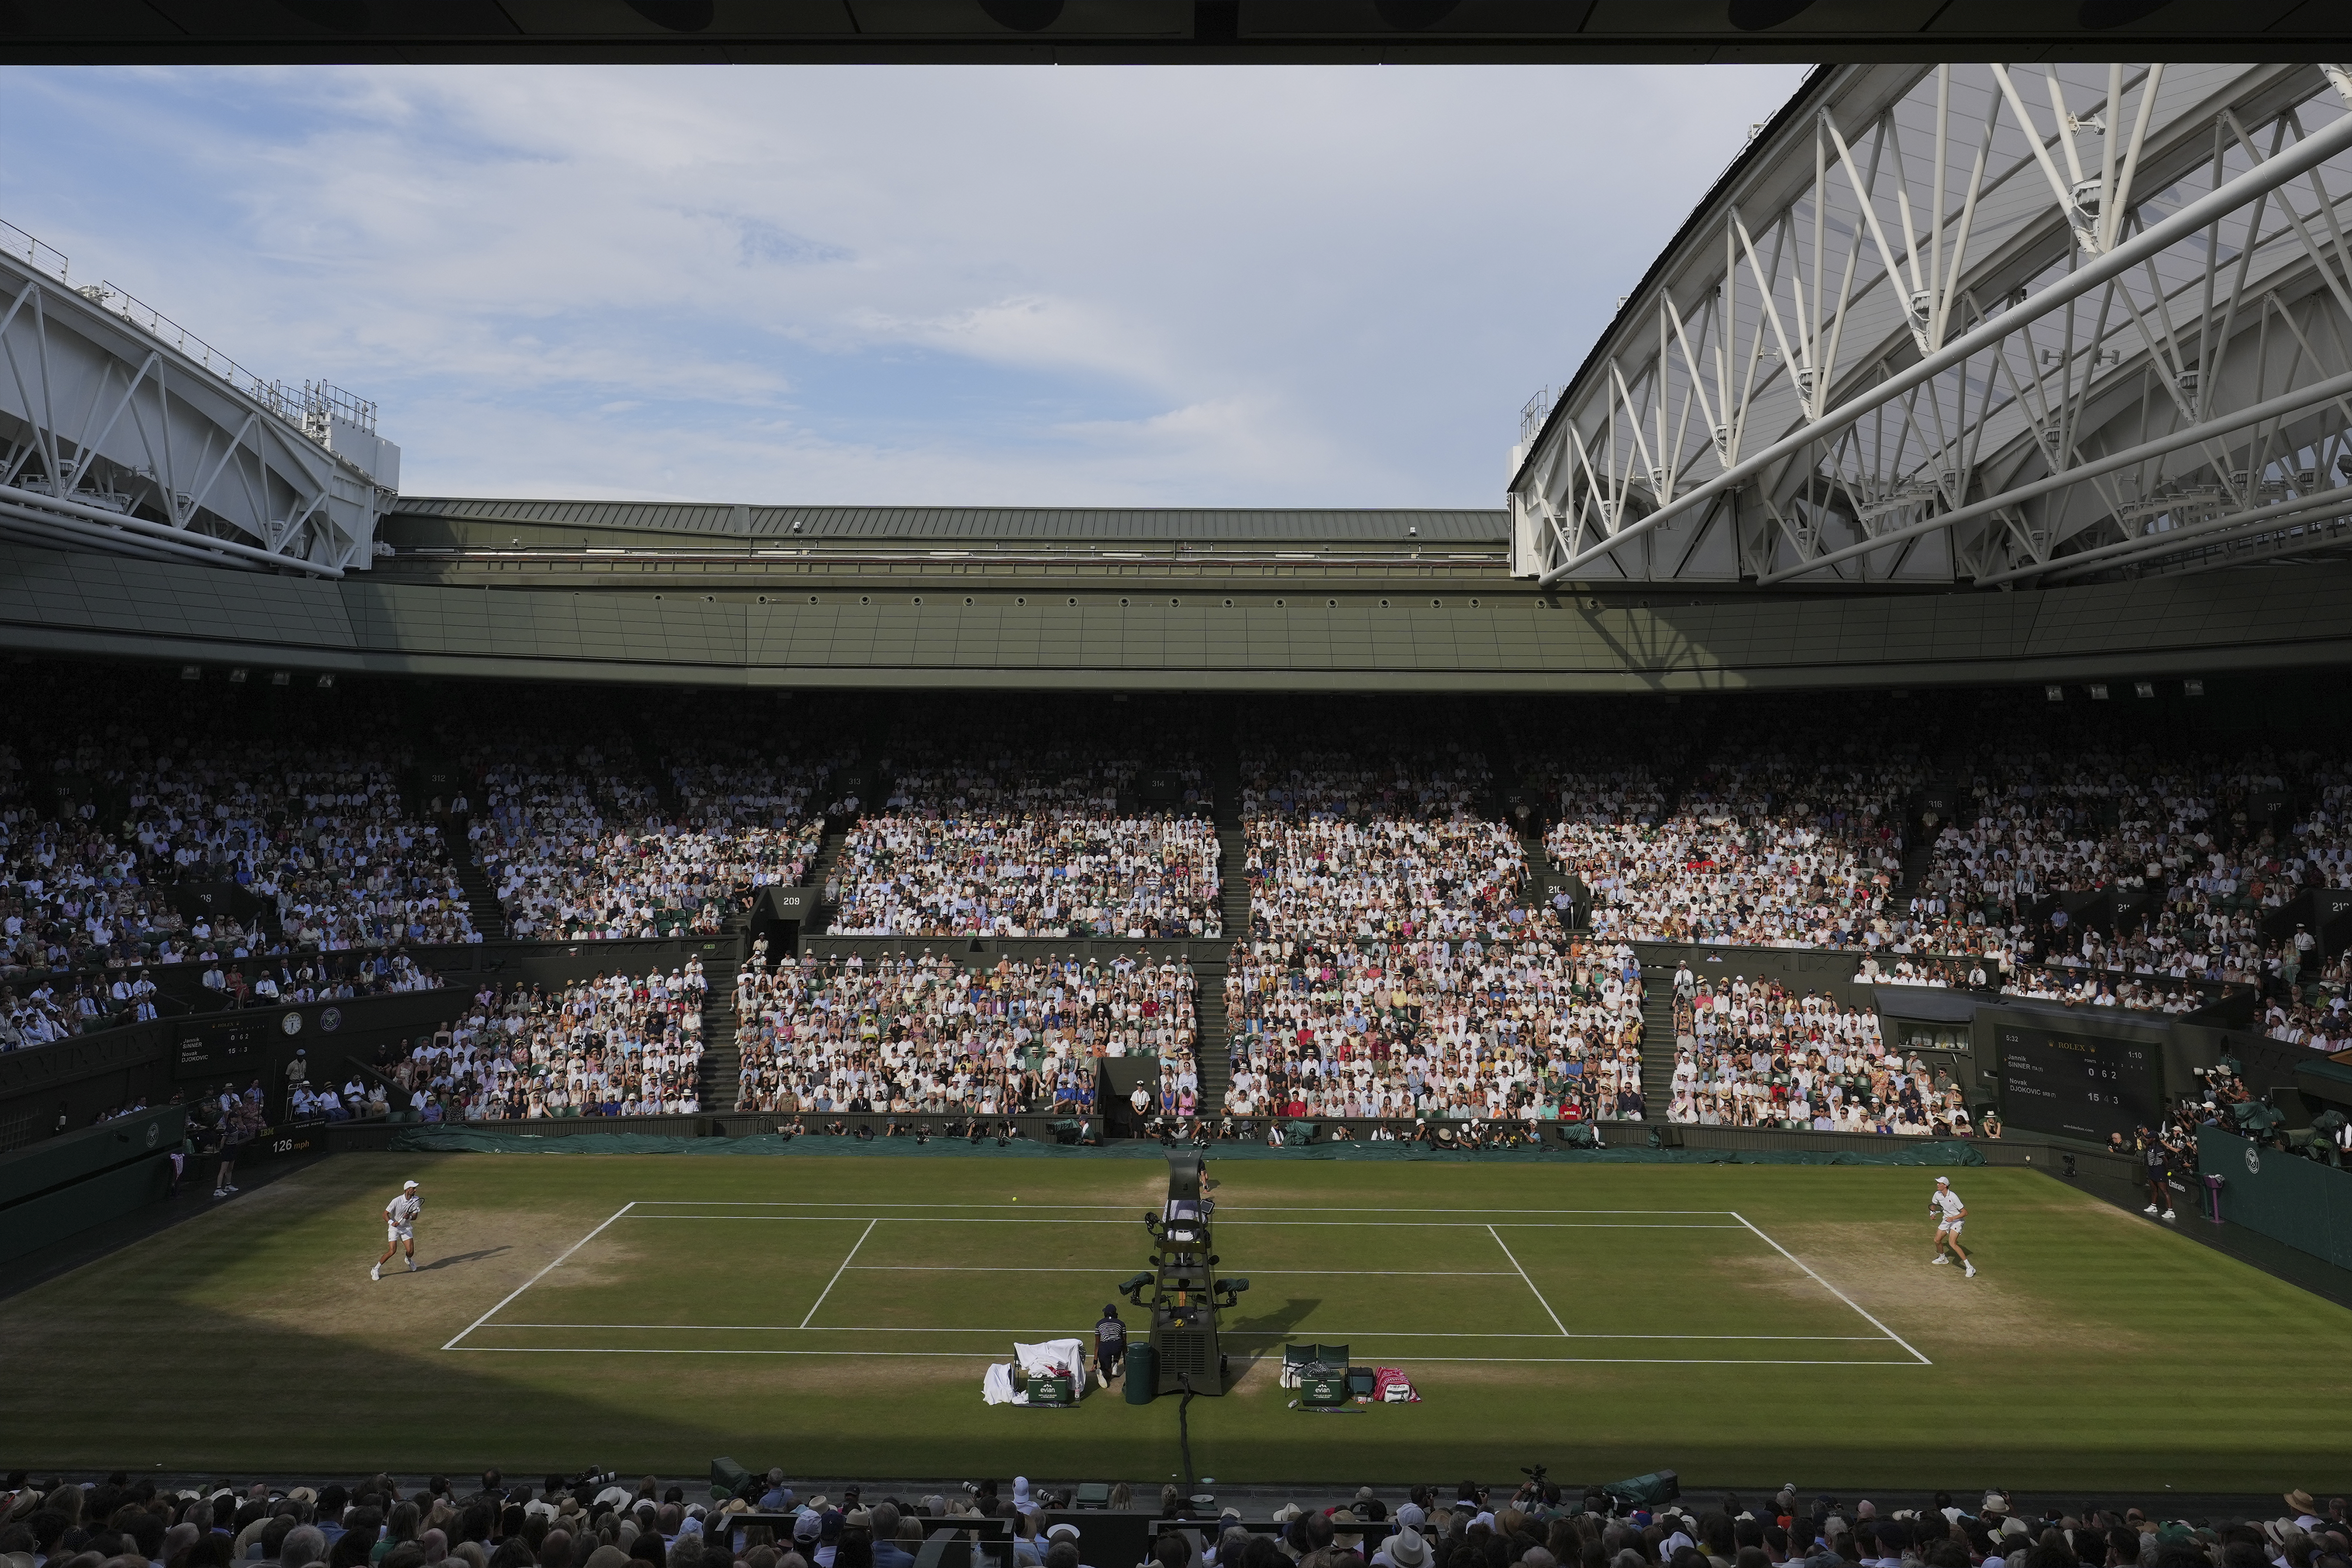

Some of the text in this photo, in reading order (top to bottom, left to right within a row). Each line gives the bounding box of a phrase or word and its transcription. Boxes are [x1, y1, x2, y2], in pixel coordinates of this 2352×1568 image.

[2058, 1042, 2086, 1051] ROLEX
[2008, 1061, 2031, 1070] SINNER
[2010, 1085, 2041, 1095] DJOKOVIC
[2088, 1093, 2099, 1101] 15
[260, 1127, 274, 1137] IBM
[273, 1138, 310, 1153] 126 mph
[2169, 1179, 2185, 1192] Emirates
